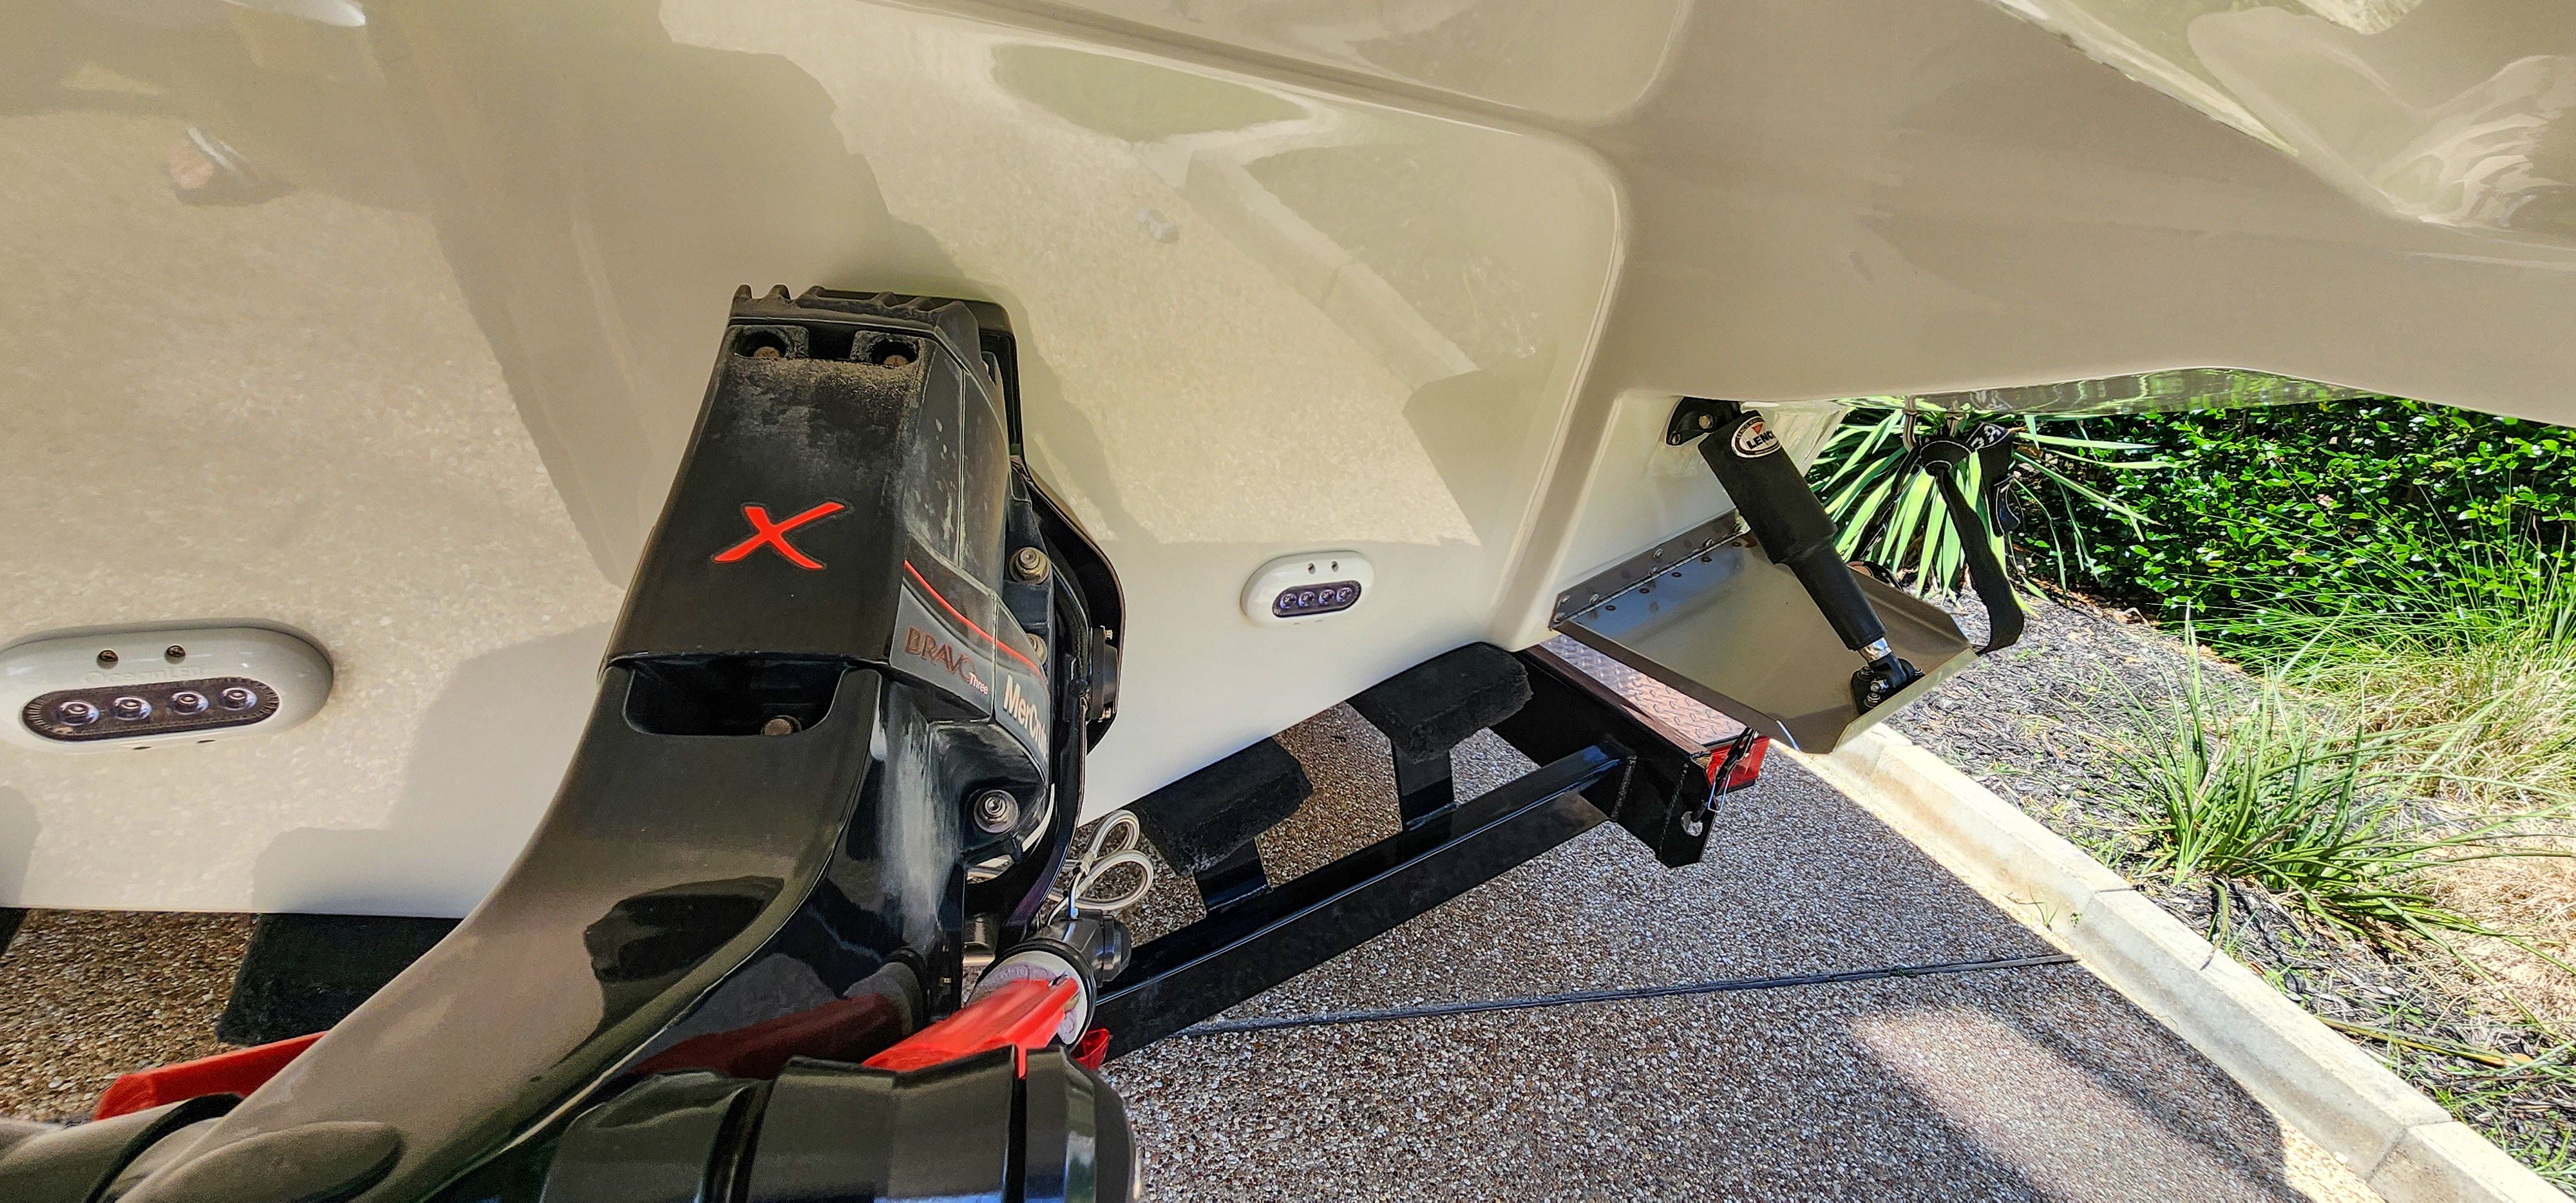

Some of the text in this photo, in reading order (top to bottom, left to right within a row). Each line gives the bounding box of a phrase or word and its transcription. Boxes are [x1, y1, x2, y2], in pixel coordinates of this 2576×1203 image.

[1746, 430, 1776, 450] LENC
[904, 625, 976, 683] BRAVO
[969, 672, 989, 695] Three
